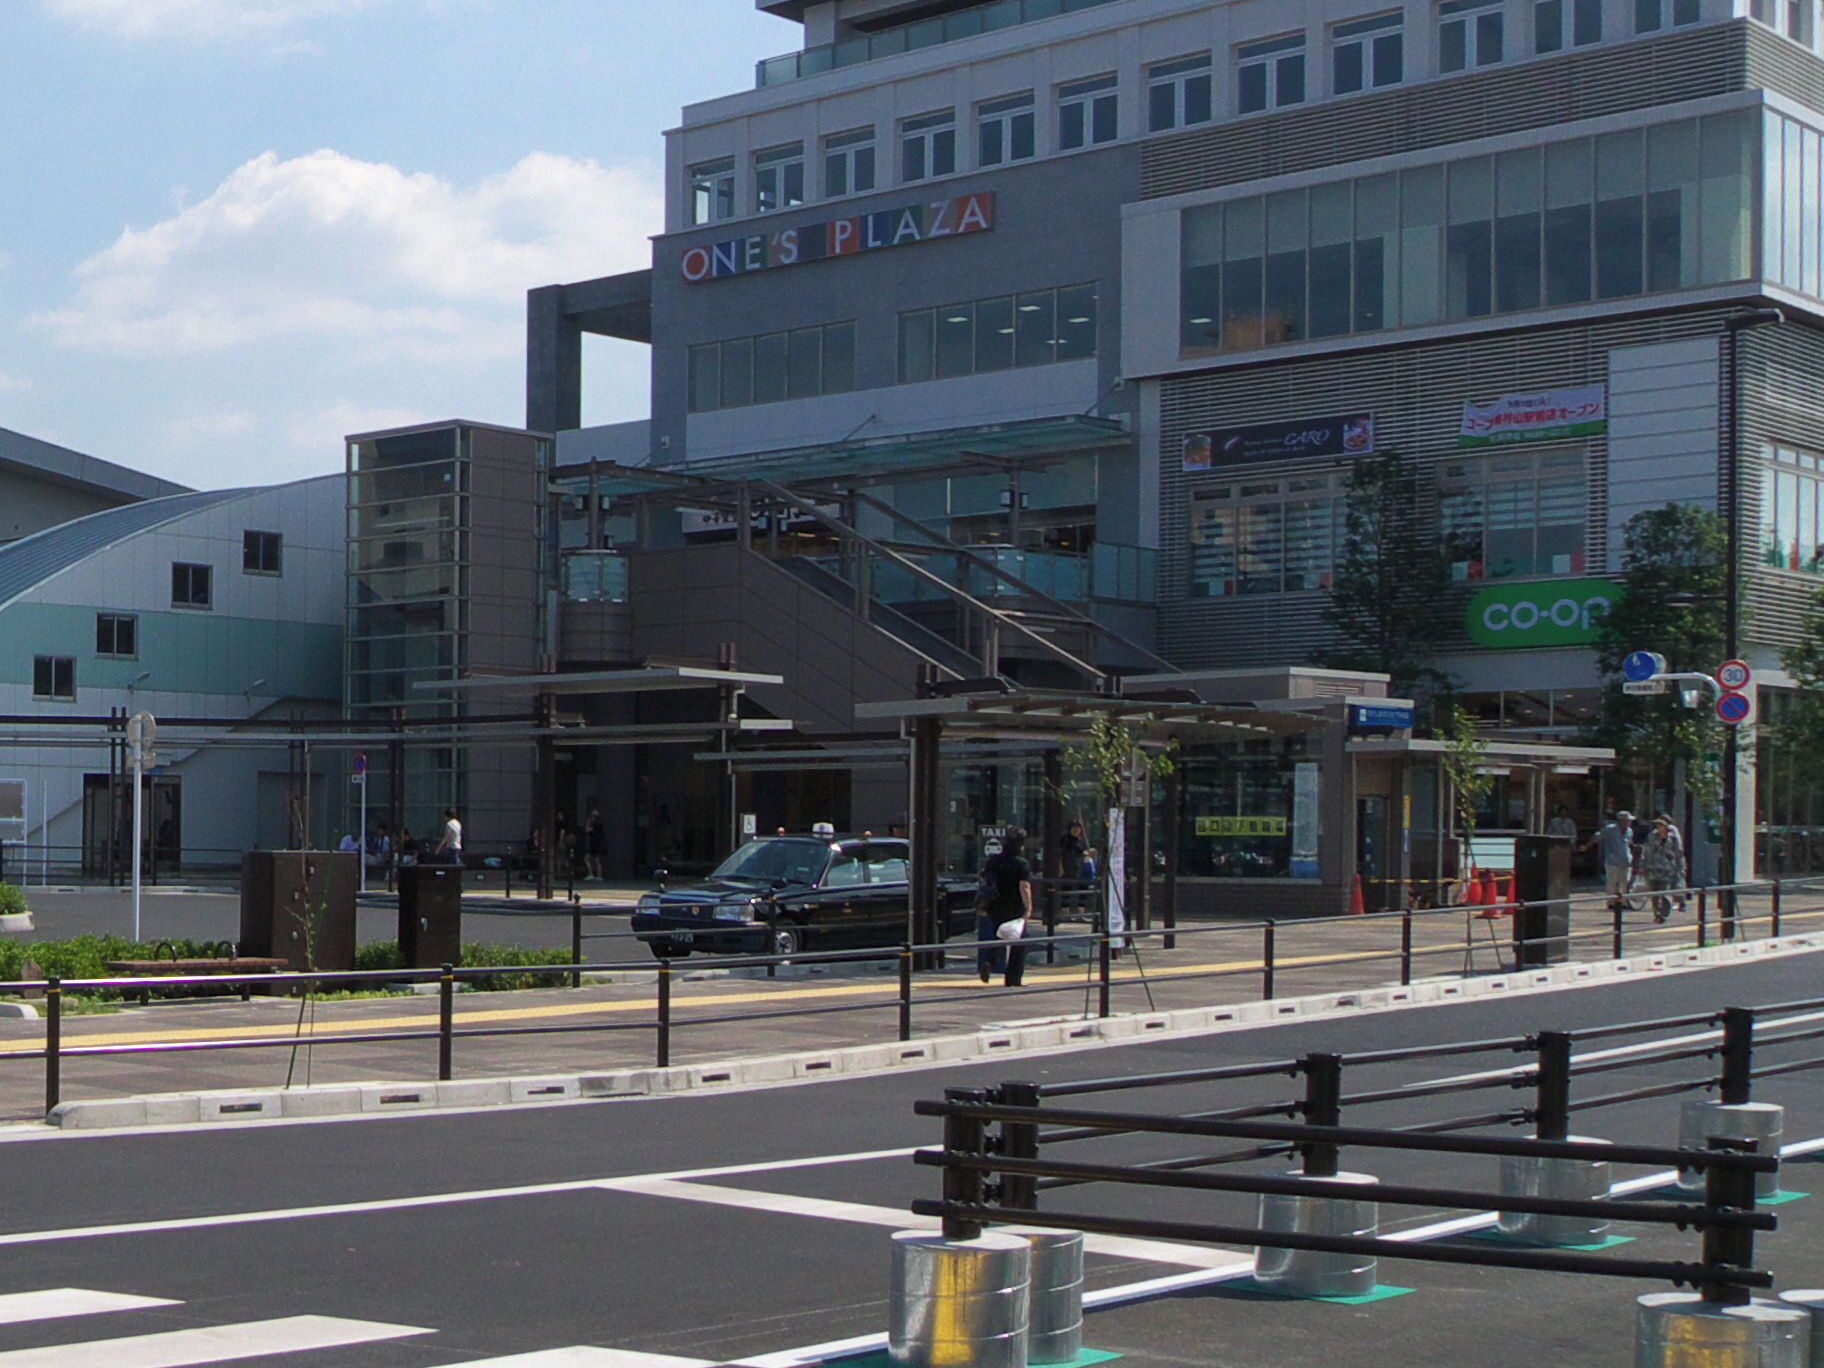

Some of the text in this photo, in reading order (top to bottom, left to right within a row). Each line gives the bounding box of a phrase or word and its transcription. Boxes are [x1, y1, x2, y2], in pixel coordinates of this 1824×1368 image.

[682, 197, 988, 281] ONE'S PLAZA
[1724, 668, 1743, 682] 30
[981, 827, 1006, 837] TAXI
